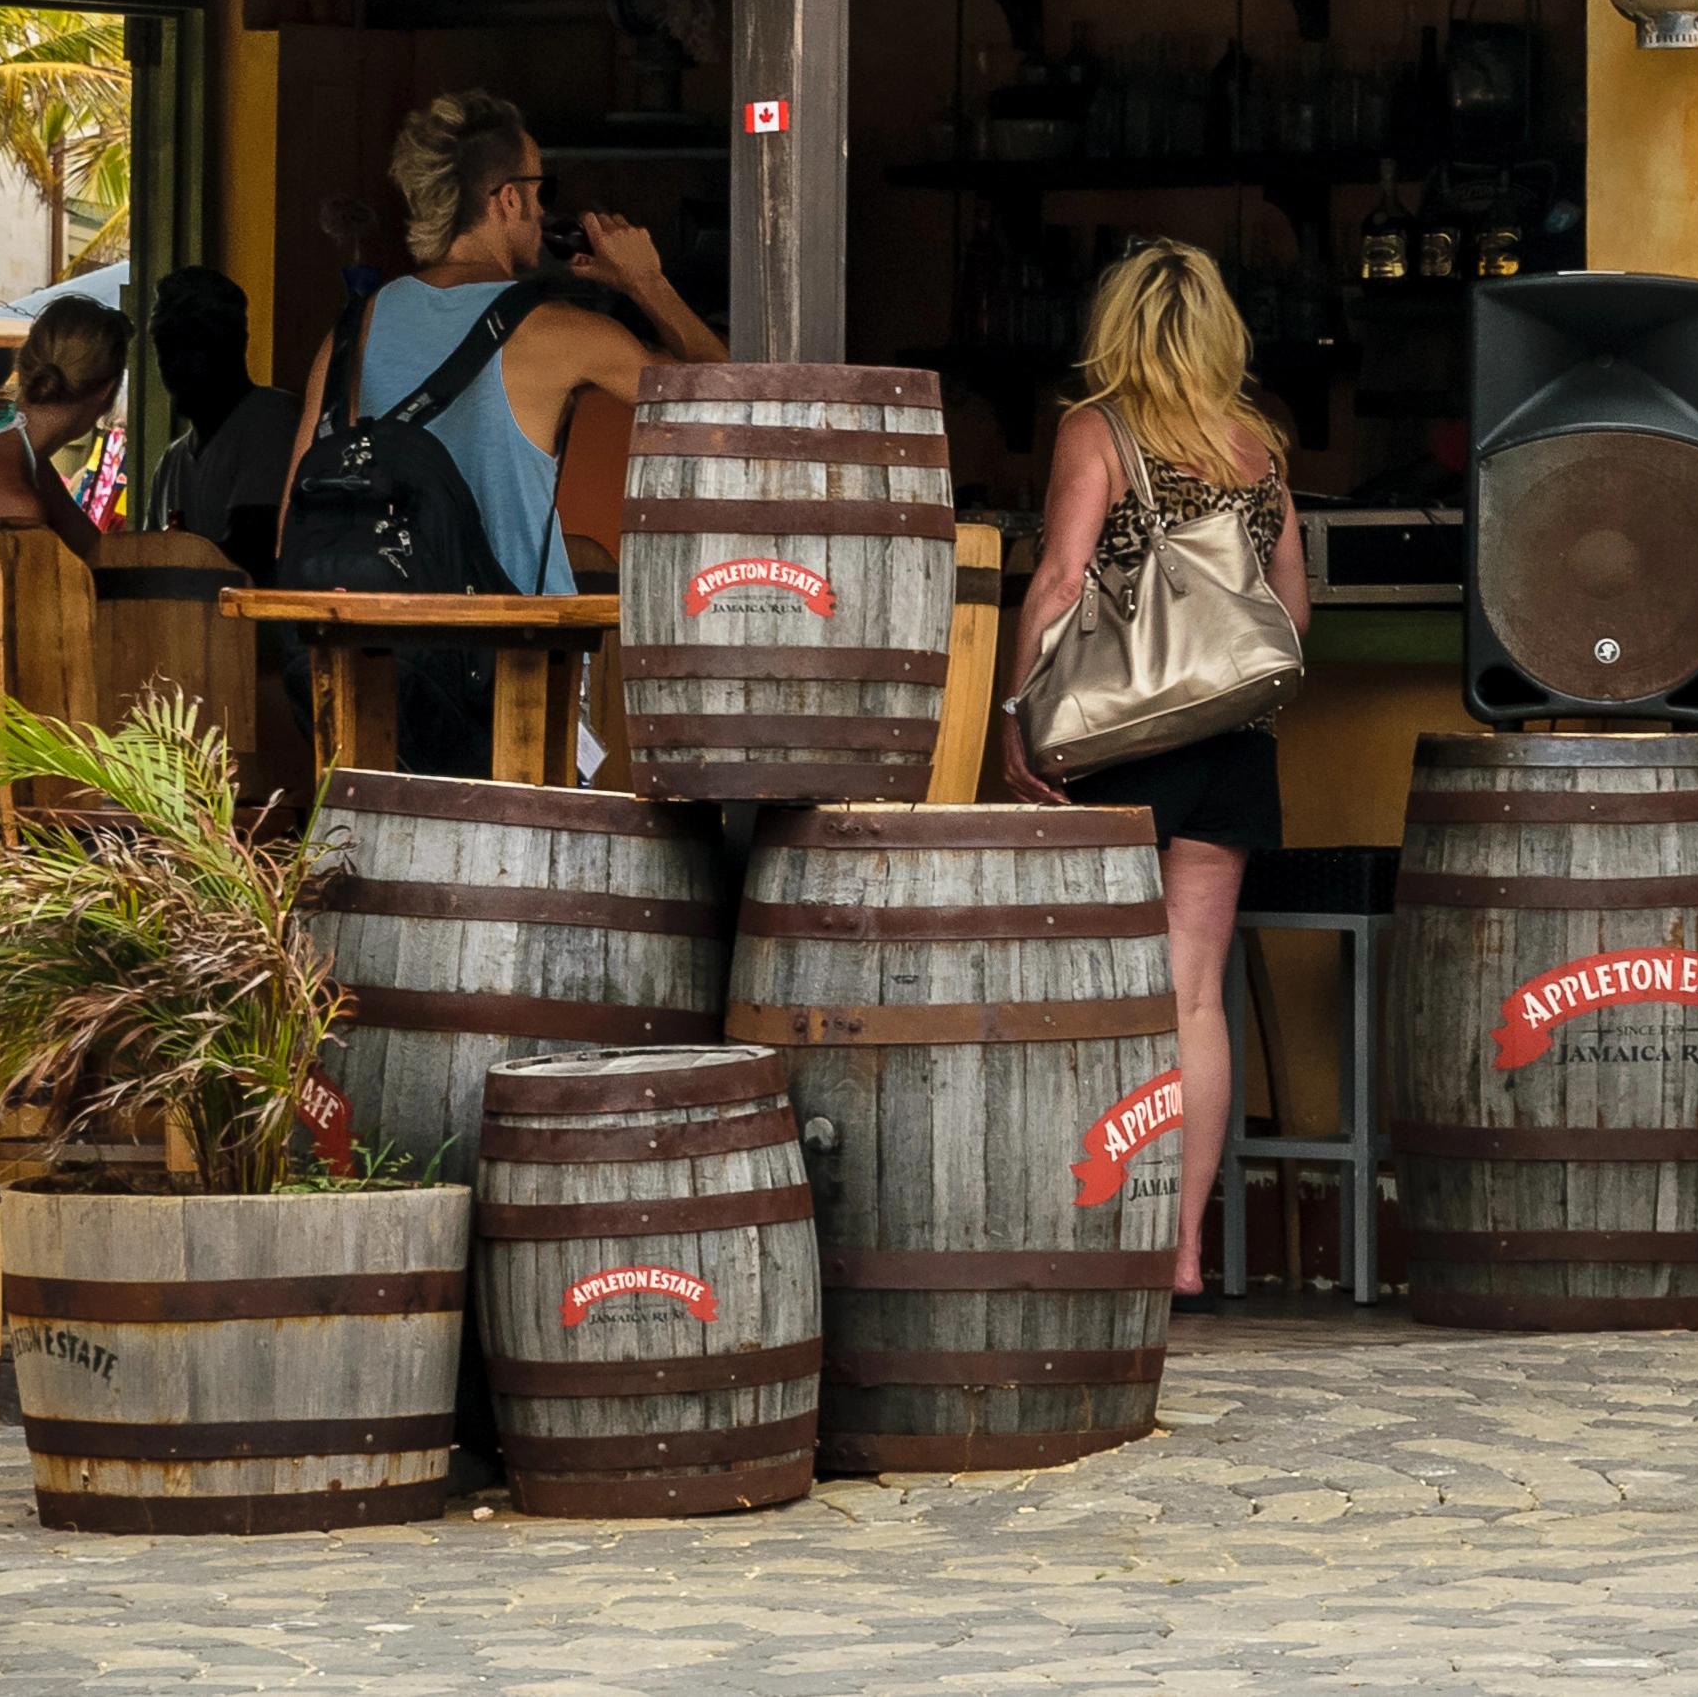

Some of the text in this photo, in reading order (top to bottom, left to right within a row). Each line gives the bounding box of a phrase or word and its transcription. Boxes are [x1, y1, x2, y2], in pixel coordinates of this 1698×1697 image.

[696, 562, 823, 597] APPLETON ESTATE
[1522, 958, 1673, 1030] APPLETON
[1616, 1024, 1656, 1037] SINCE
[1555, 1043, 1671, 1065] JAMAICA
[301, 1077, 339, 1130] ATE
[572, 1269, 705, 1307] APPLETON ESTATE
[44, 1324, 118, 1382] ESTATE
